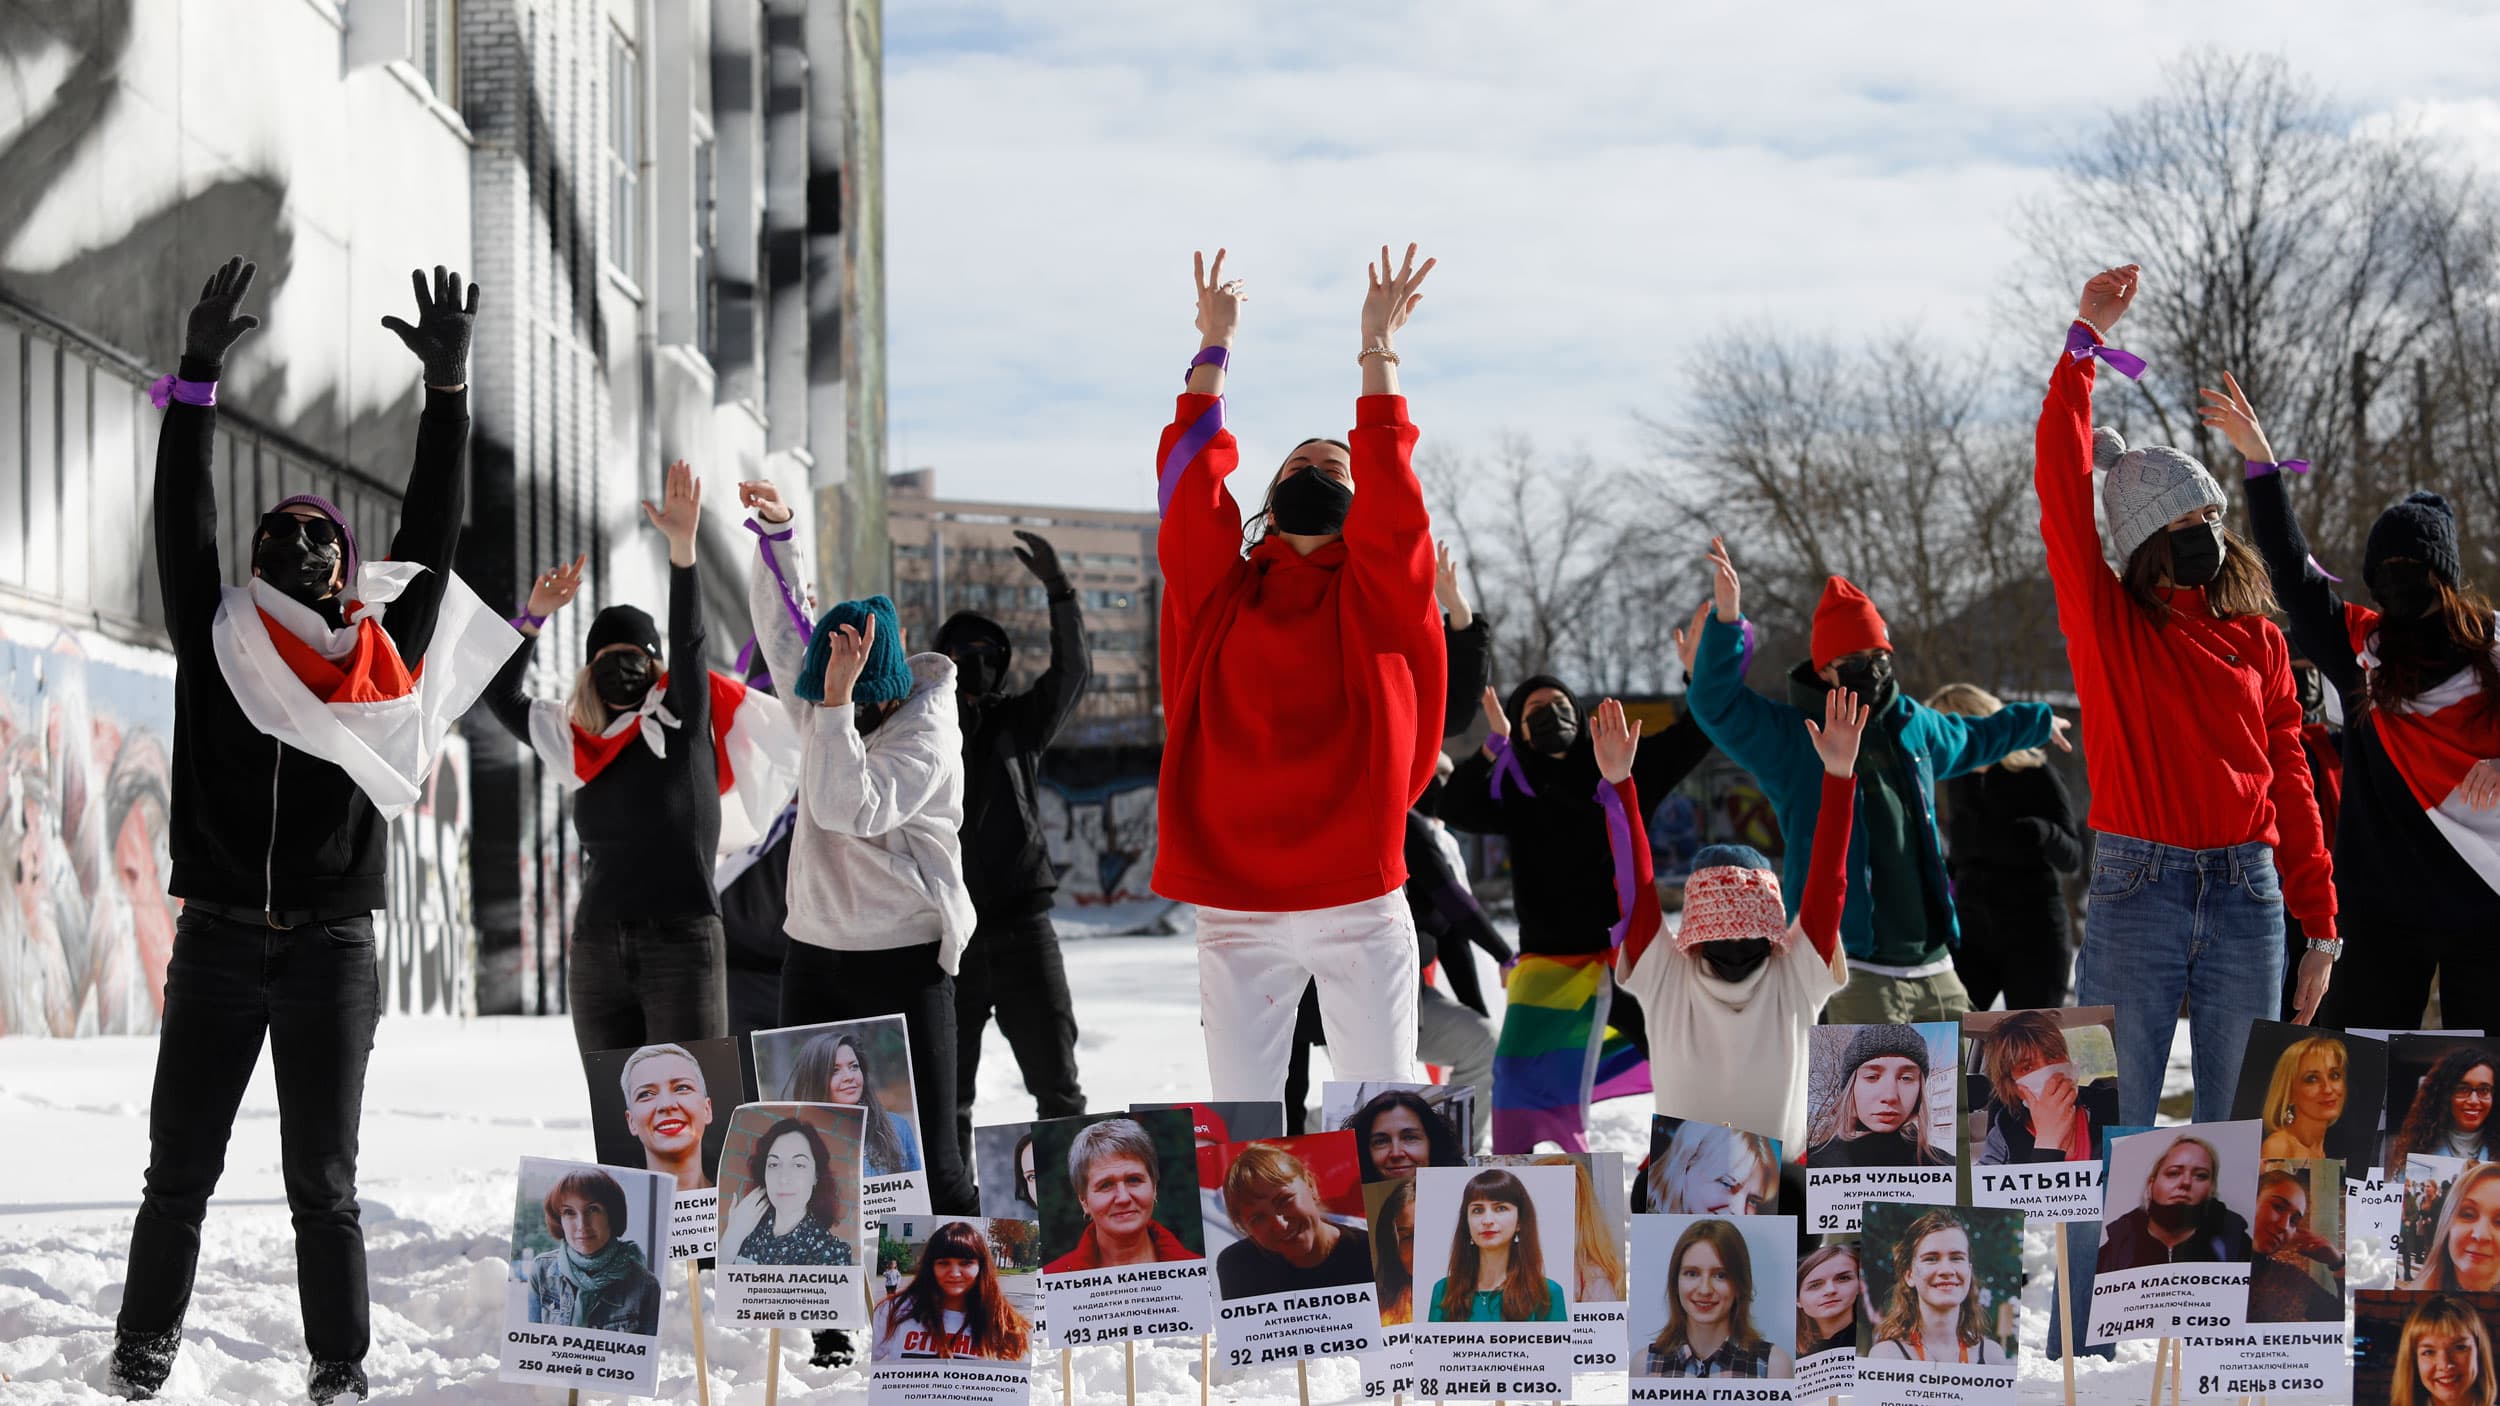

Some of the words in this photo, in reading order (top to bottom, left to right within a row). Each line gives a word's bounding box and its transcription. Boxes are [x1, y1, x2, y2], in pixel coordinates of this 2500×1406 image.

[1809, 1173, 1861, 1186] ДАРЬЯ
[1866, 1172, 1953, 1185] ЧУЛЬЦОВА
[2010, 1197, 2042, 1205] МАМА
[2045, 1194, 2087, 1203] ТИМУРА
[2047, 1207, 2099, 1217] 24.09.2020
[1818, 1215, 1839, 1229] 92
[690, 1243, 699, 1254] В
[728, 1272, 785, 1283] ТАТЬЯНА
[788, 1273, 849, 1285] ЛАСИЦА
[1045, 1276, 1112, 1292] ТАТЬЯНА
[1118, 1266, 1207, 1283] КАНЕВСКАЯ
[2094, 1281, 2136, 1295] ОЛЬГА
[2141, 1275, 2250, 1288] КЛАСКОВСКАЯ
[747, 1287, 827, 1296] правозащитница,
[1090, 1287, 1138, 1299] ДОВЕРЕННОЕ
[1140, 1285, 1162, 1293] ЛИЦО
[2140, 1290, 2195, 1299] АКТИВИСТКА,
[742, 1296, 830, 1305] политзаключённая
[1073, 1300, 1123, 1311] КАНДИДАТКИ
[1131, 1295, 1183, 1304] ПРЕЗИДЕНТЫ,
[1221, 1302, 1278, 1319] ОЛЬГА
[1284, 1291, 1371, 1311] ПАВЛОВА
[2123, 1301, 2211, 1313] ПОЛИТЗАКЛЮЧЁННАЯ
[737, 1309, 751, 1320] 25
[754, 1309, 785, 1320] дней
[789, 1311, 797, 1320] в
[800, 1310, 838, 1321] СИЗО
[1264, 1313, 1331, 1326] АКТИВИСТКА,
[2171, 1316, 2181, 1326] В
[2187, 1316, 2231, 1327] СИЗО
[1064, 1328, 1091, 1344] 193
[1097, 1326, 1128, 1341] ДНЯ
[1133, 1325, 1143, 1335] В
[1148, 1321, 1194, 1334] СИЗО.
[1245, 1323, 1353, 1342] ПОЛИТЗАКЛЮЧЁННАЯ
[508, 1331, 558, 1346] ОЛЬГА
[562, 1336, 646, 1356] РАДЕЦКАЯ
[1415, 1335, 1485, 1344] КАТЕРИНА
[1490, 1335, 1570, 1344] БОРИСЕВИЧ
[2184, 1336, 2257, 1347] ТАТЬЯНА
[2263, 1334, 2344, 1346] ЕКЕЛЬЧИК
[551, 1350, 606, 1362] художница
[1230, 1348, 1253, 1366] 92
[1261, 1345, 1298, 1362] ДНЯ
[1304, 1344, 1315, 1355] В
[1321, 1338, 1368, 1354] СИЗО
[1452, 1351, 1529, 1359] ЖУРНАЛИСТКА,
[2240, 1351, 2289, 1359] СТУДЕНТКА,
[1573, 1353, 1616, 1365] СИЗО
[519, 1359, 543, 1371] 250
[546, 1364, 582, 1375] дней
[585, 1368, 593, 1376] в
[597, 1367, 635, 1381] СИЗО
[1440, 1362, 1545, 1372] ПОЛИТЗАКЛЮЧЁННАЯ
[2219, 1362, 2309, 1371] ПОЛИТЗАКЛЮЧЁННАЯ
[873, 1371, 939, 1380] АНТОНИНА
[943, 1371, 1028, 1384] КОНОВАЛОВА
[1858, 1370, 1915, 1383] КСЕНИЯ
[1919, 1374, 2014, 1388] СЫРОМОЛОТ
[1365, 1380, 1385, 1398] 95
[1420, 1378, 1439, 1395] 88
[1446, 1379, 1490, 1395] ДНЕЙ
[1497, 1382, 1507, 1393] В
[1513, 1382, 1562, 1393] СИЗО.
[2199, 1375, 2219, 1394] 81
[2281, 1378, 2324, 1390] СИЗО
[904, 1393, 993, 1402] ПОЛИТЗАКЛЮЧЁННАЯ
[1632, 1389, 1707, 1400] МАРИНА
[1713, 1389, 1792, 1401] ГЛАЗОВА
[1905, 1390, 1964, 1400] СТУДЕНТКА,
